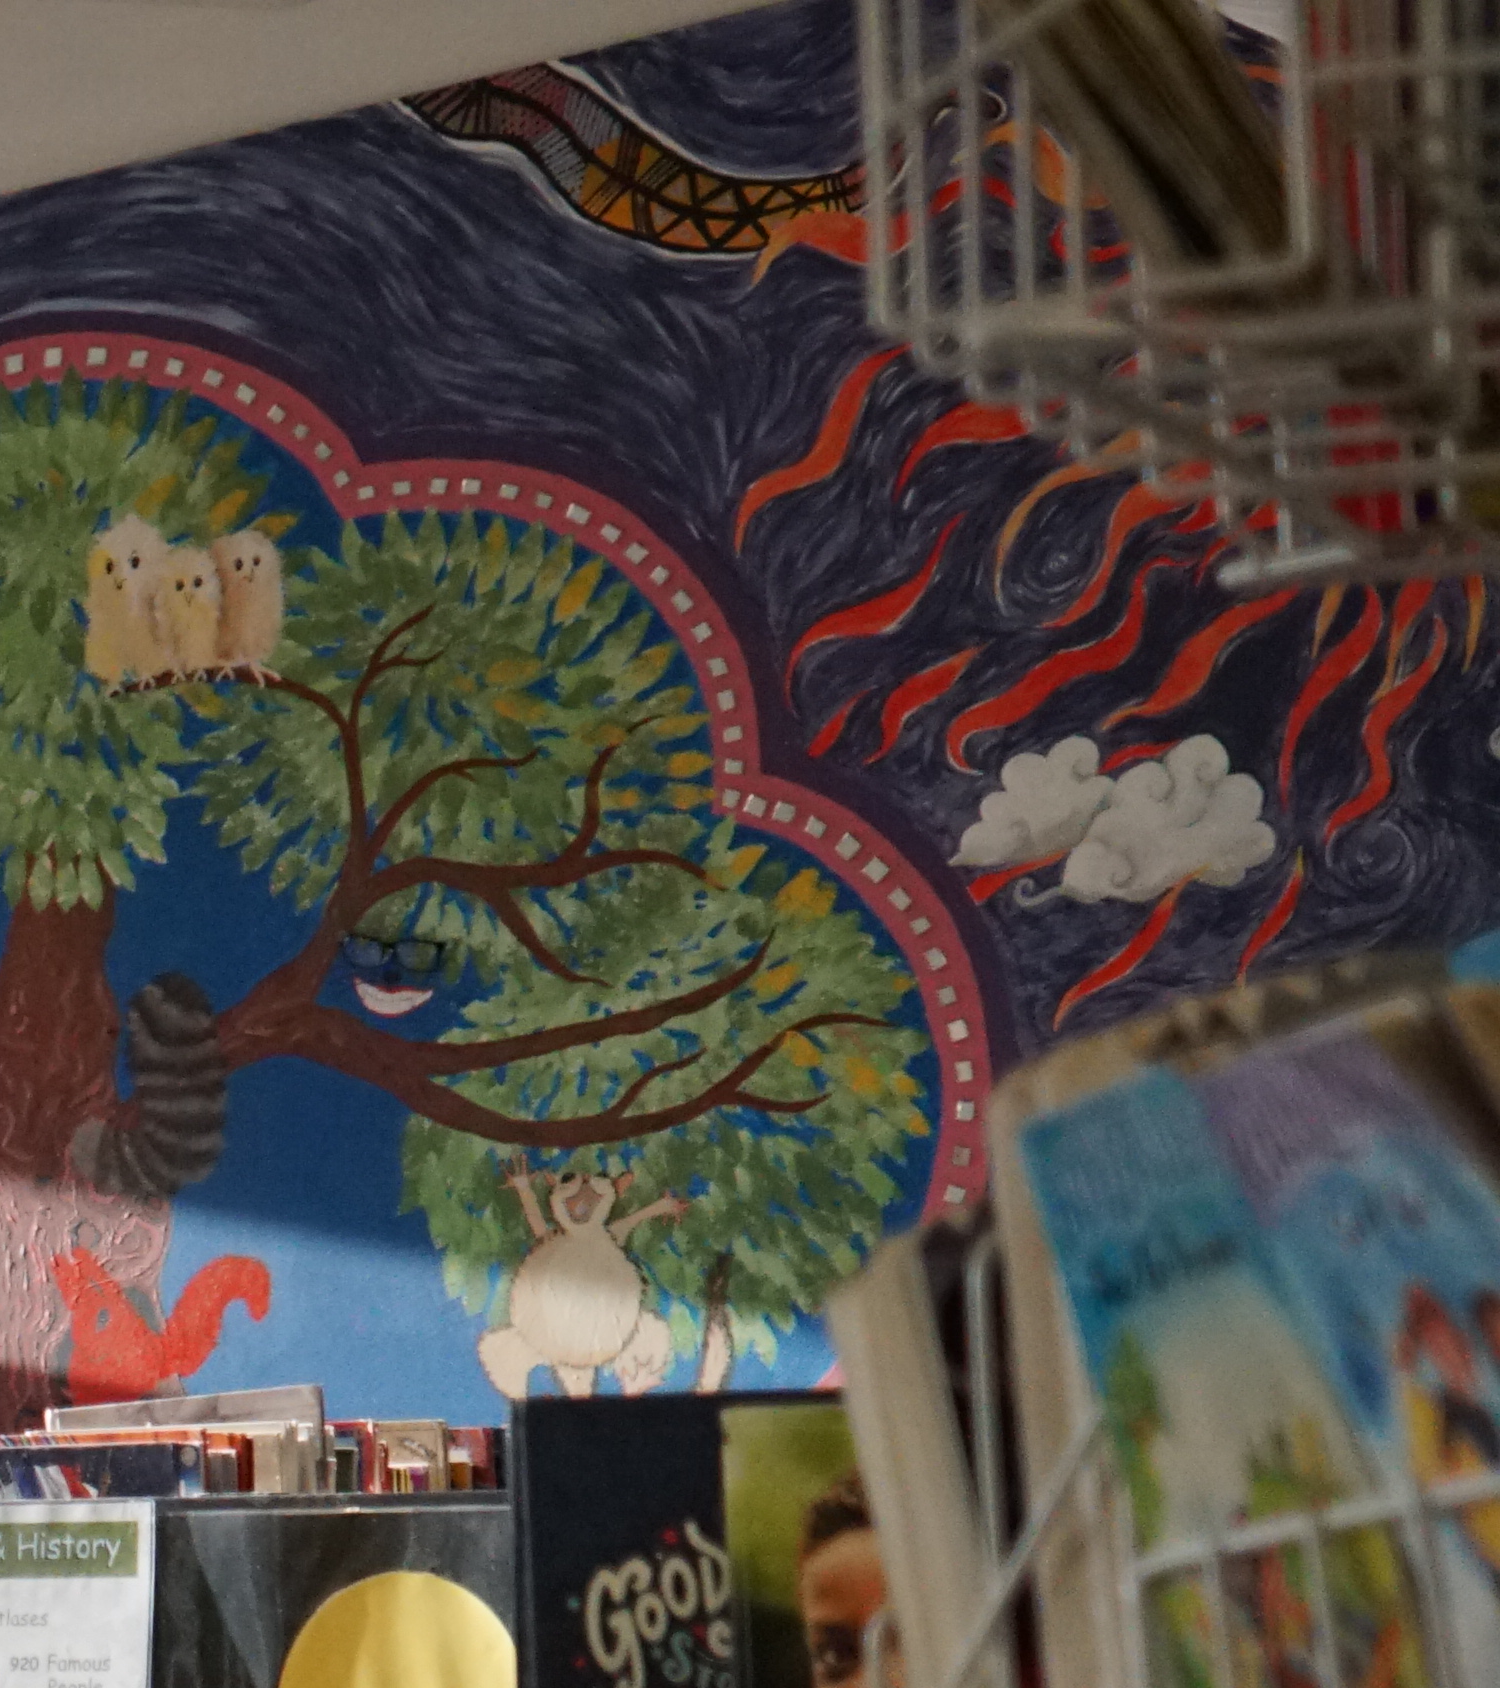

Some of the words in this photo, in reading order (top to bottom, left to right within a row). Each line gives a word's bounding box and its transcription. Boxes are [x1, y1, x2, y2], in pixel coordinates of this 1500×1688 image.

[16, 1532, 122, 1567] History
[10, 1656, 40, 1672] 920
[47, 1655, 111, 1672] Famous
